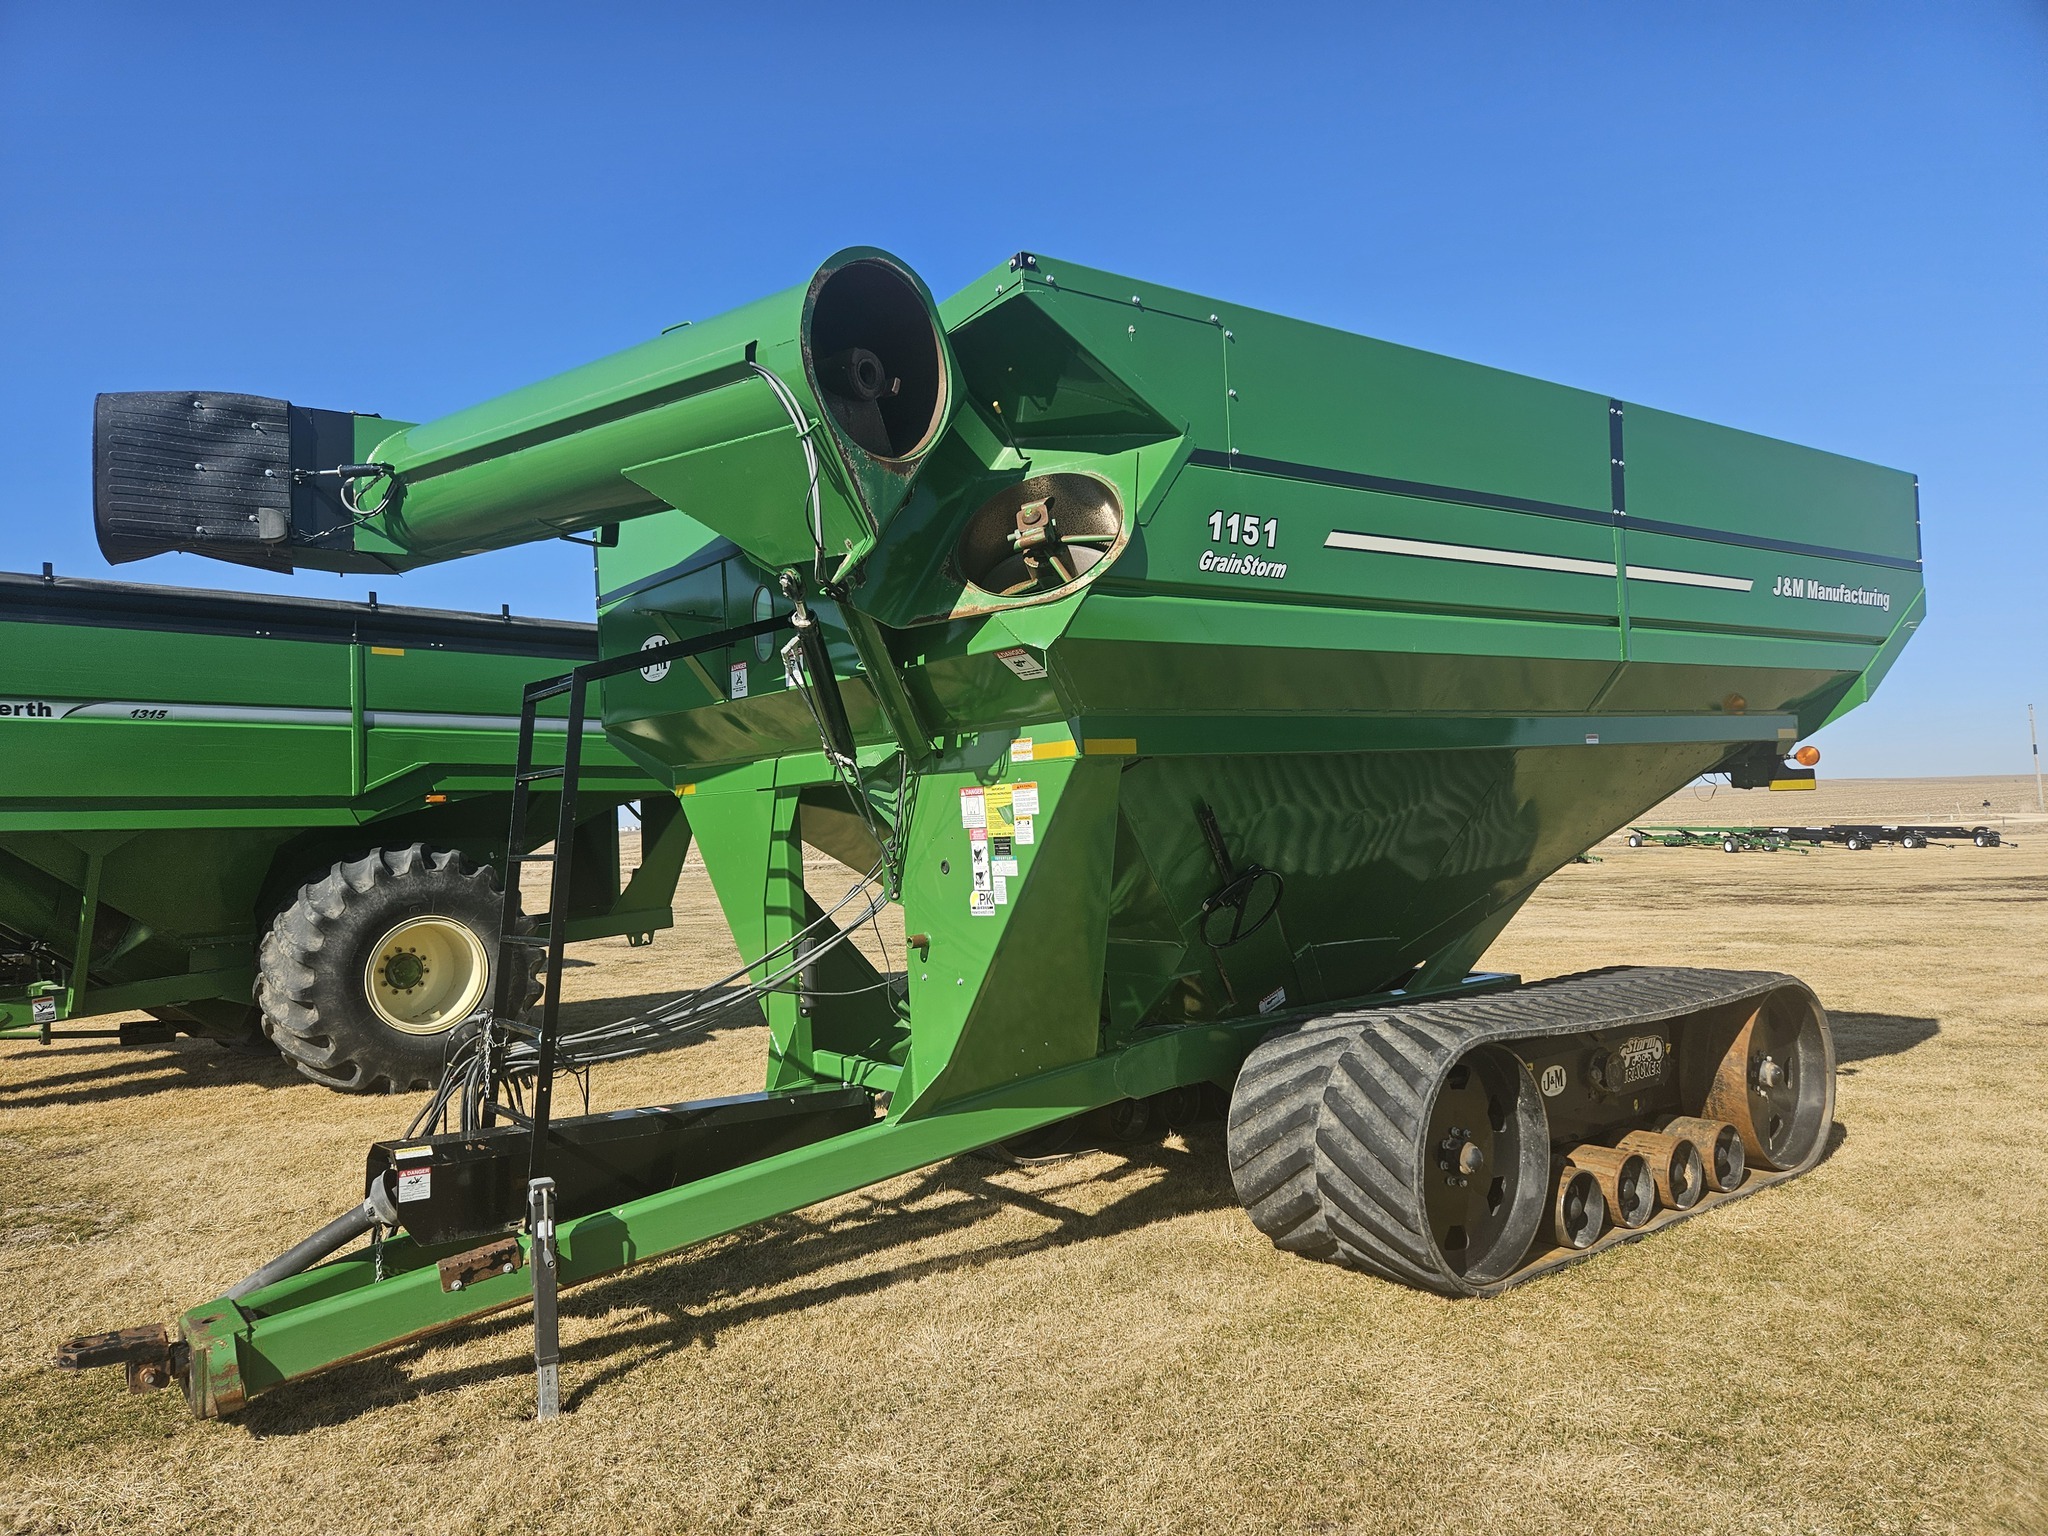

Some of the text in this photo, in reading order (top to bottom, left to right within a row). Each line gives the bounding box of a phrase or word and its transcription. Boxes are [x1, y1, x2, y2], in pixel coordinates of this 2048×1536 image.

[1207, 509, 1279, 549] 1151
[1198, 550, 1288, 579] GrainStorm
[1772, 575, 1891, 612] J&M Manufacturing
[130, 708, 168, 720] 1315
[1626, 1037, 1656, 1053] Storm
[1543, 1068, 1564, 1091] J&M
[1624, 1061, 1661, 1083] RACKER
[406, 1168, 430, 1176] DANGER
